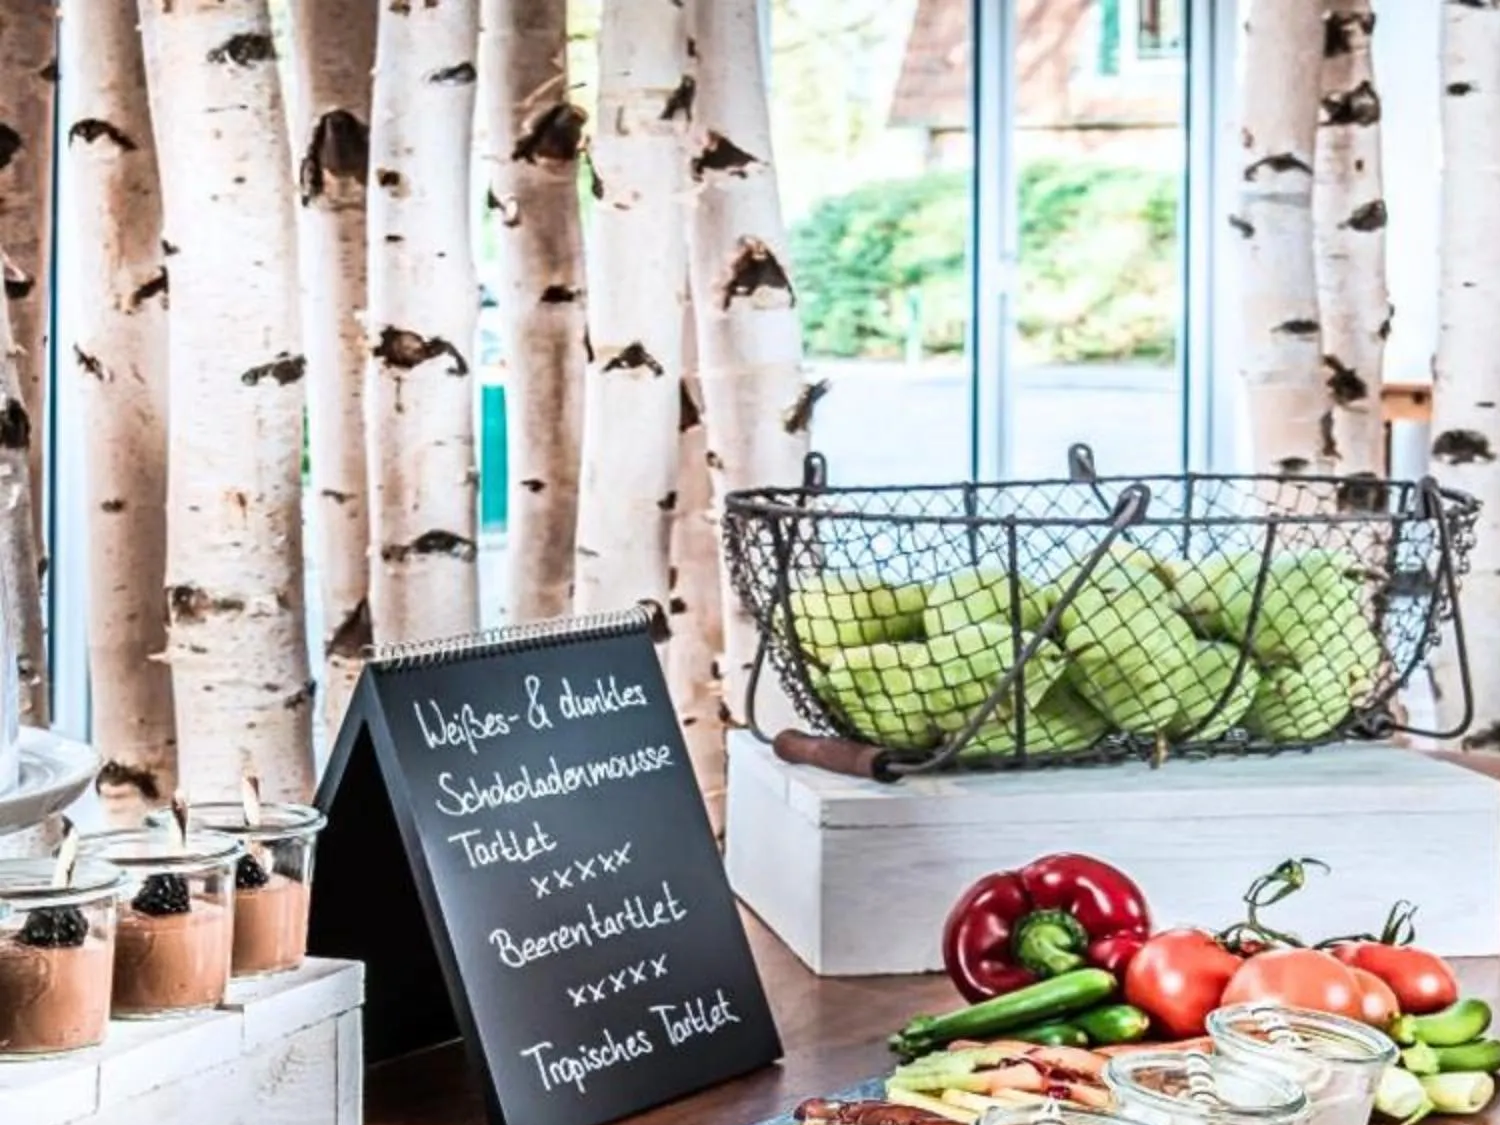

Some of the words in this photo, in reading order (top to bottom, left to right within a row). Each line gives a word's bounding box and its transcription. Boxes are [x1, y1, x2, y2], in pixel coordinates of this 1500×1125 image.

[524, 674, 551, 731] &
[559, 675, 648, 719] dunkles
[448, 822, 557, 870] Tartlet
[520, 1025, 653, 1094] Tropisches
[649, 989, 740, 1046] Tartlet
